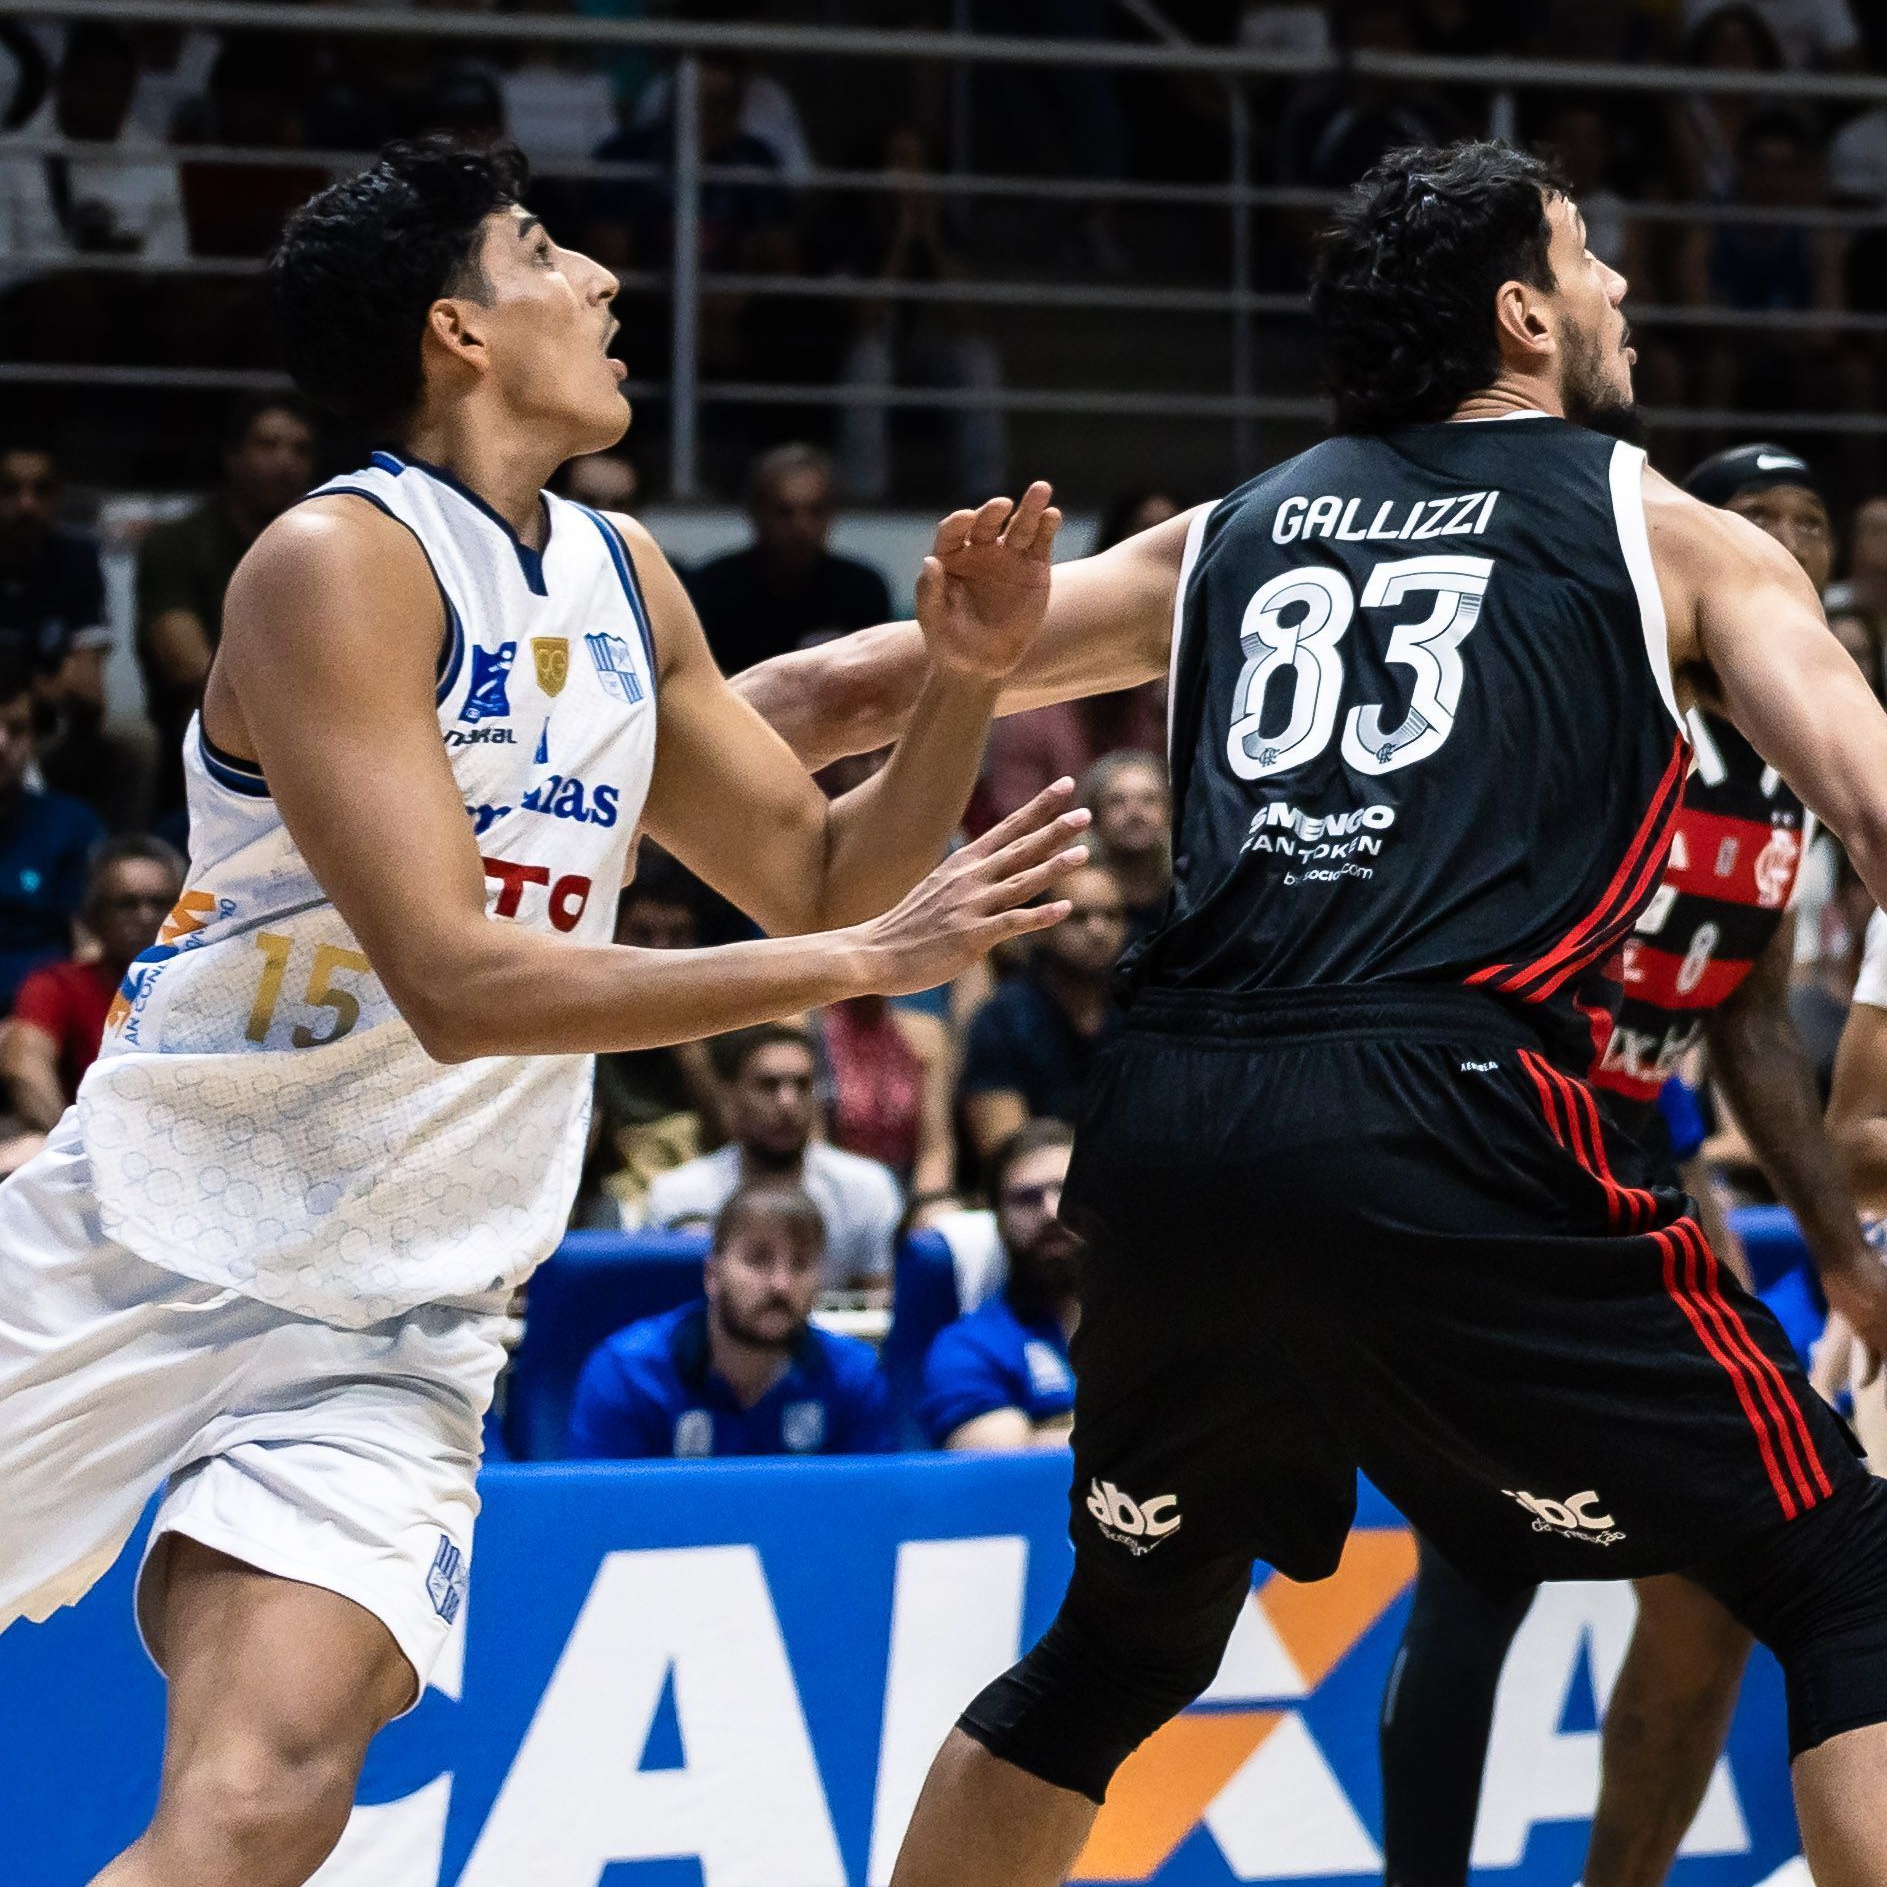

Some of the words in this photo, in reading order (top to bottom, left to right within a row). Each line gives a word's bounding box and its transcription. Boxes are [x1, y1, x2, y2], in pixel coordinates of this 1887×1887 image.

[1271, 490, 1500, 545] GALLIZZI
[1226, 554, 1496, 781] 83
[480, 856, 594, 934] TO
[243, 932, 370, 1050] 15
[300, 1532, 1752, 1887] AIXA
